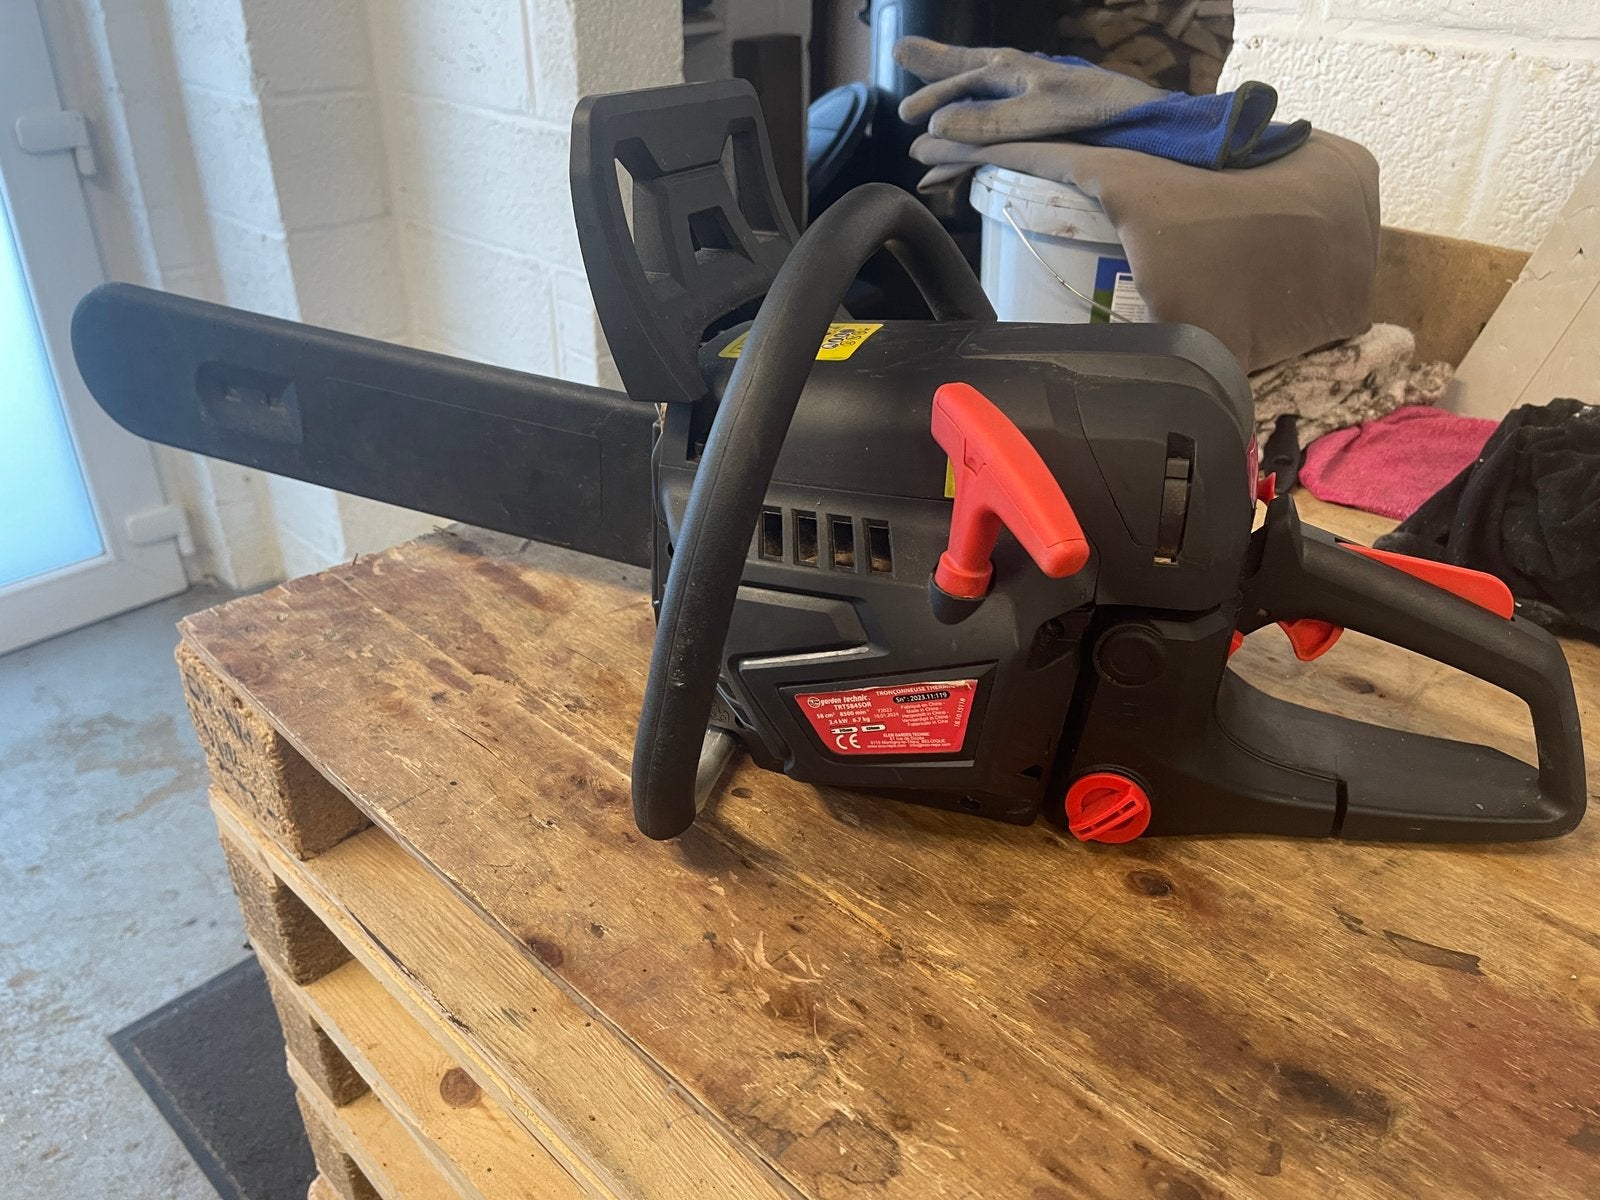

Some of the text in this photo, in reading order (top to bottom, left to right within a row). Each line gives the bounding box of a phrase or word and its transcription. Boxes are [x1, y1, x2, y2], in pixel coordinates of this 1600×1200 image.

[876, 686, 926, 696] TRONÇONNEUSE
[820, 698, 842, 706] garden
[844, 694, 868, 703] technic
[910, 692, 947, 702] 2023.11:119
[836, 733, 861, 750] CE
